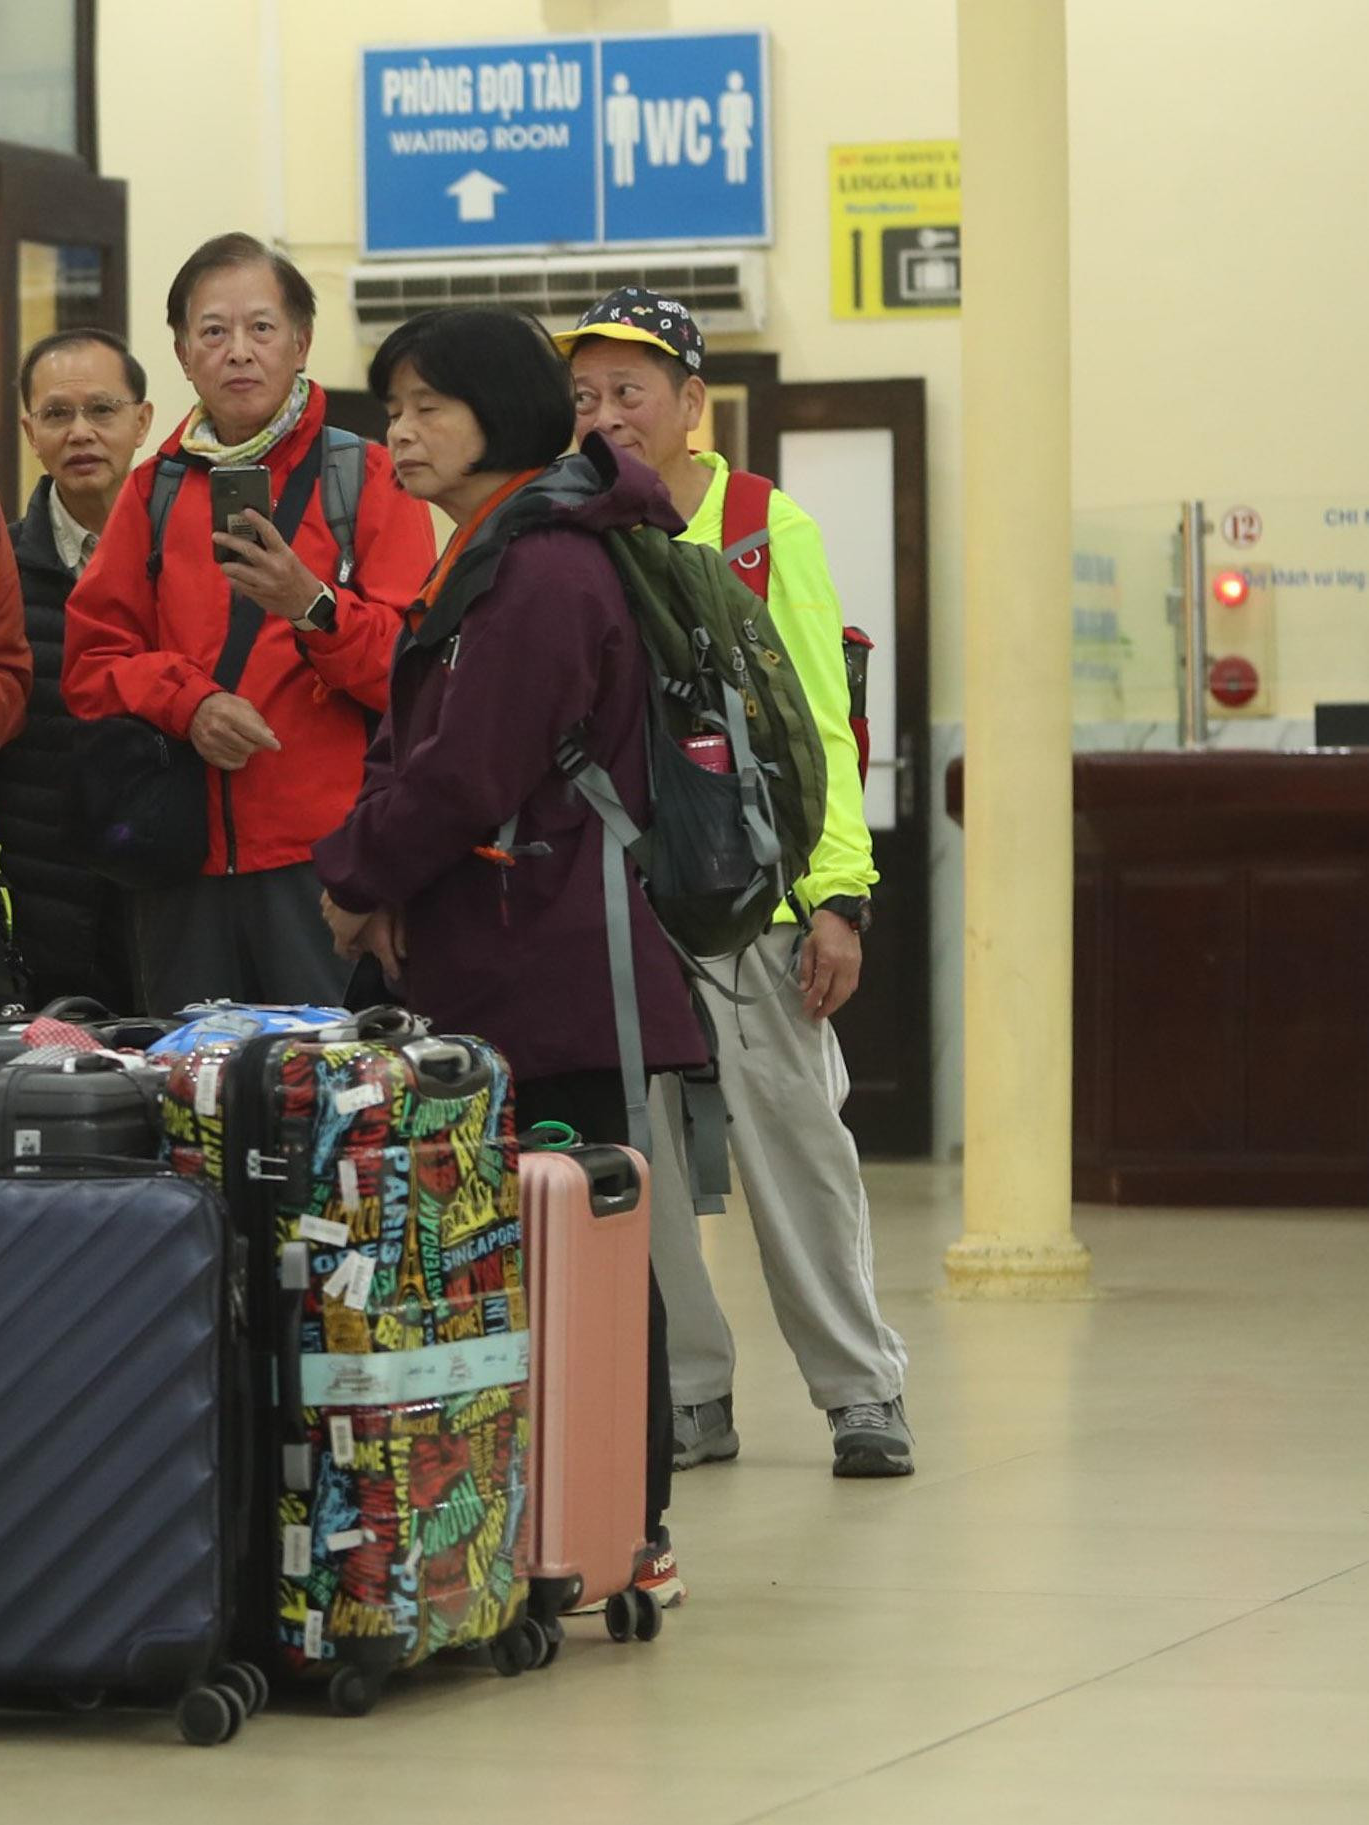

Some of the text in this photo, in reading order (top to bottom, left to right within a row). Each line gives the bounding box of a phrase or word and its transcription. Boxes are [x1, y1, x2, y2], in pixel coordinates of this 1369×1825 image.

[382, 52, 581, 121] PHÒNG ĐỢI TÀU
[390, 122, 570, 155] WAITING ROOM
[643, 96, 712, 166] WC
[838, 172, 937, 194] LUGGAGE
[1232, 514, 1256, 542] 12
[380, 1145, 411, 1264] PARIS
[418, 1188, 451, 1320] AMSTERDAM
[442, 1220, 521, 1272] SINGAPORE
